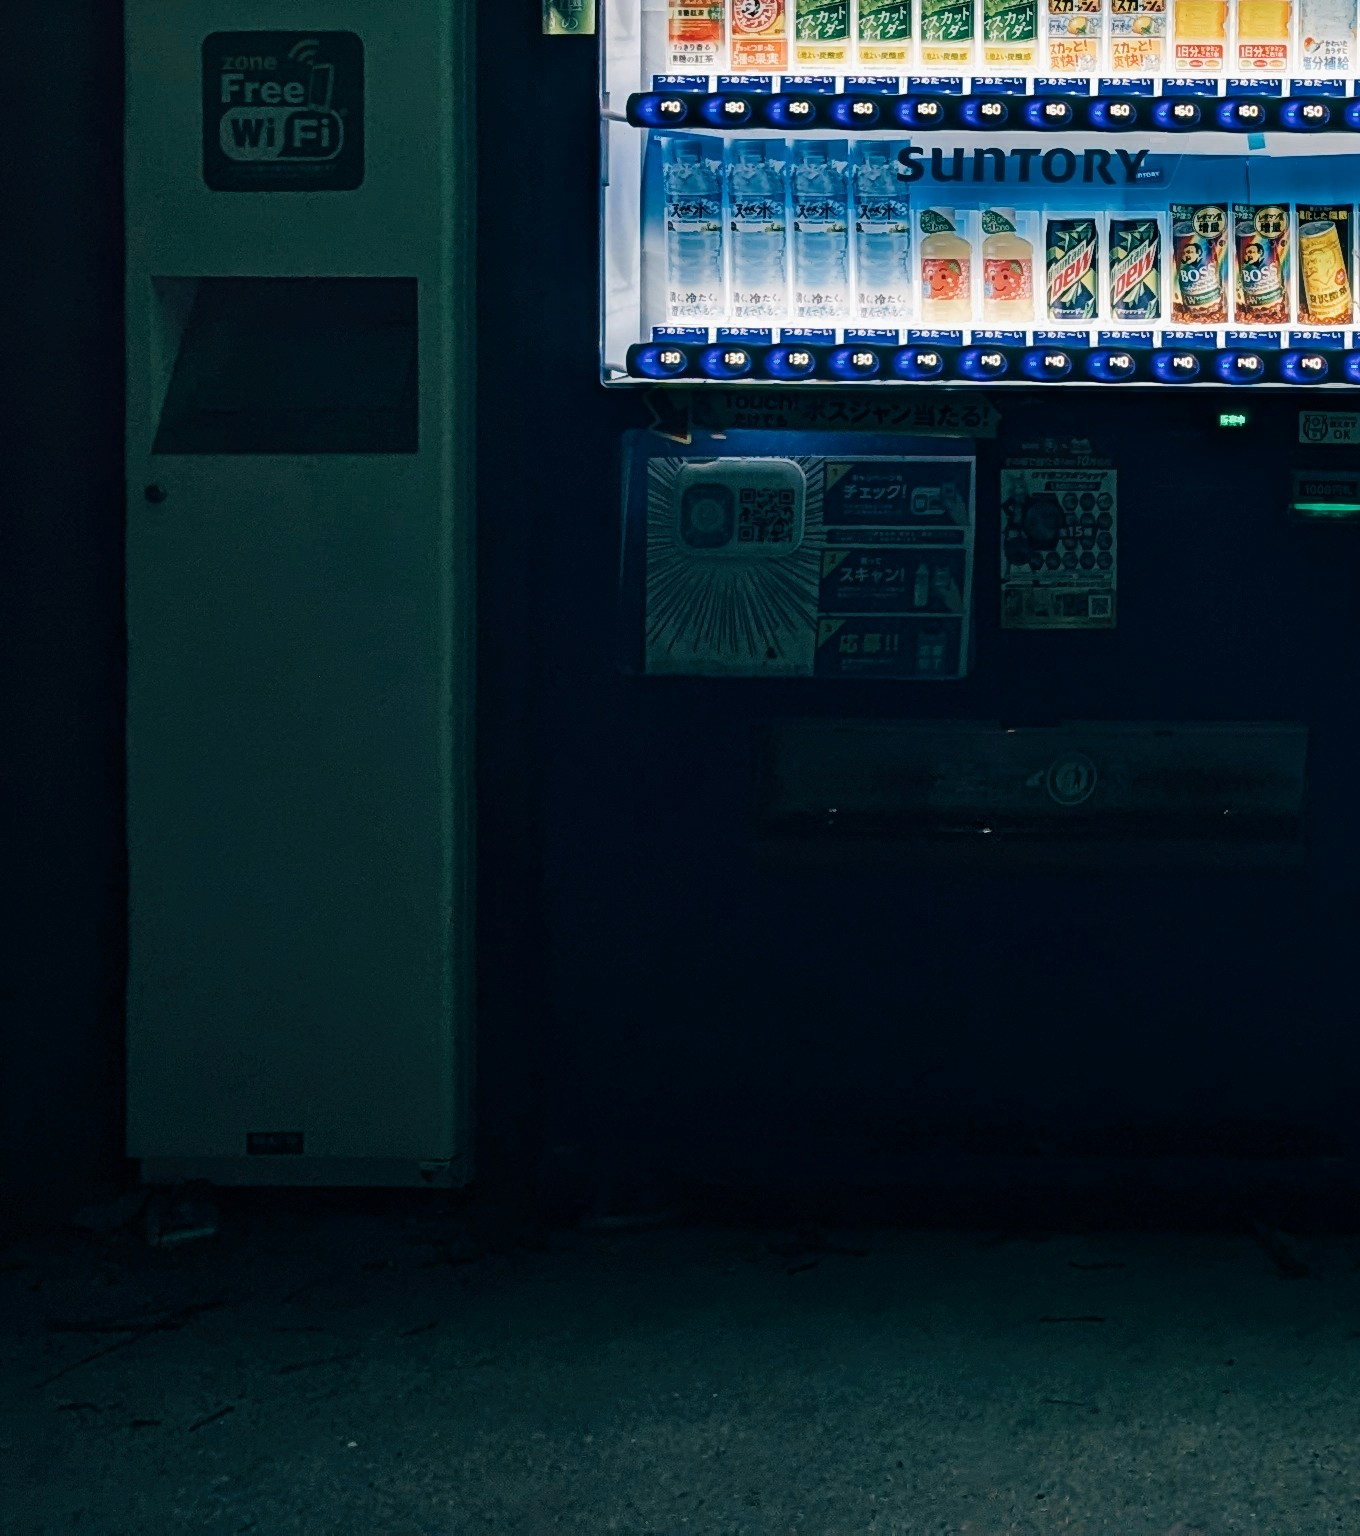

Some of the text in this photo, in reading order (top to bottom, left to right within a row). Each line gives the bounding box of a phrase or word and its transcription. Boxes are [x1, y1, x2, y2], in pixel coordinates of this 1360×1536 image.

[796, 7, 846, 29] マスカット
[801, 23, 844, 40] サイダー
[864, 23, 906, 42] サイダー
[1050, 40, 1087, 54] スカッと!
[1114, 40, 1152, 54] スカッと!
[221, 54, 277, 72] zone
[1051, 55, 1079, 68] 爽快!
[221, 74, 305, 104] Free
[897, 146, 1150, 185] SUNTORY
[1180, 263, 1217, 283] BOSS
[1242, 263, 1279, 283] BOSS
[843, 484, 907, 500] チェック!
[840, 567, 905, 582] スキャン!
